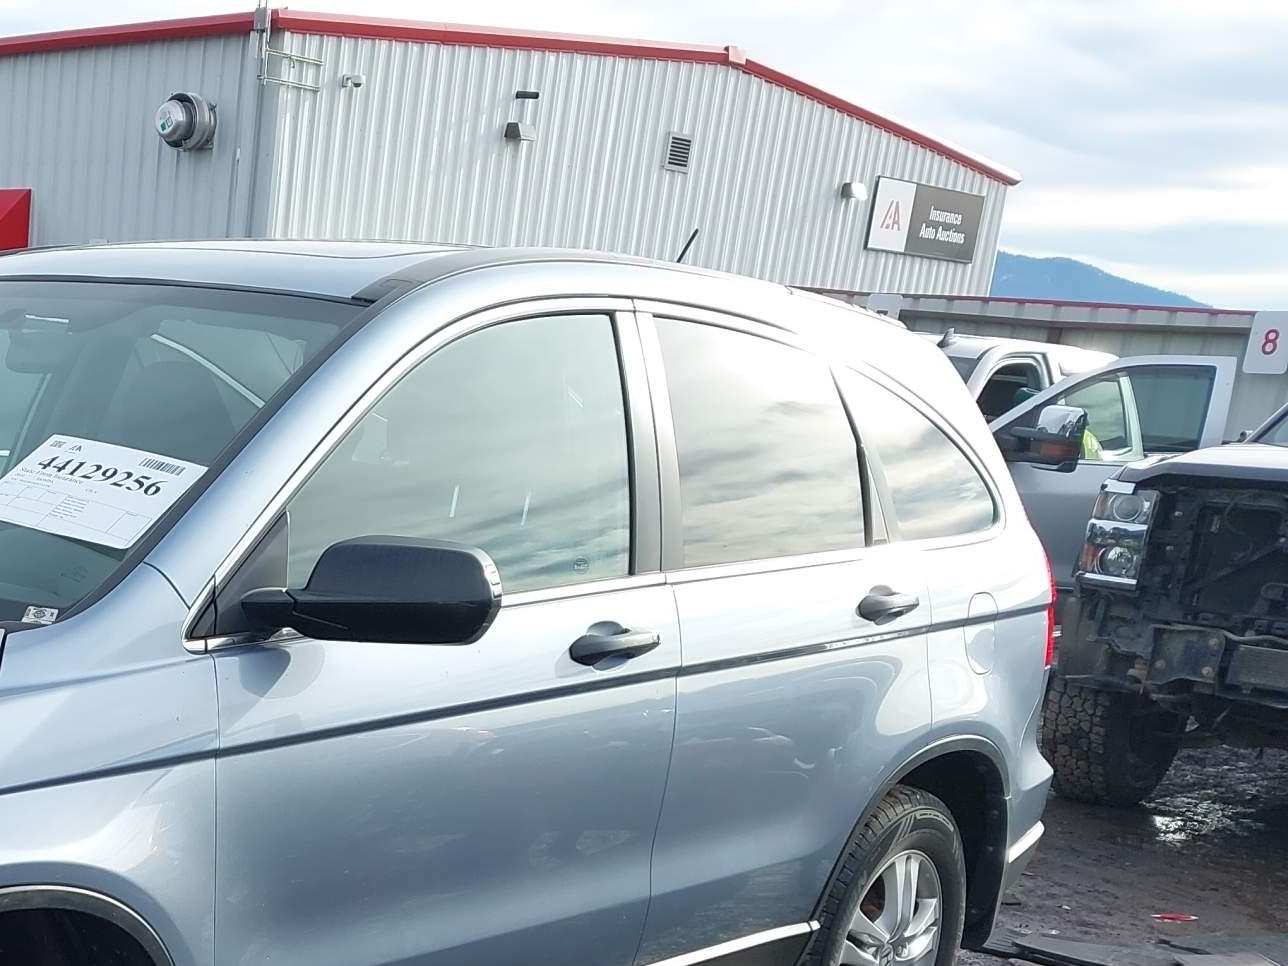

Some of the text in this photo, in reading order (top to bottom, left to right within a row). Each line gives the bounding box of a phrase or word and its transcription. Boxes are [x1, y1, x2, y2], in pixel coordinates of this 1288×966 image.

[929, 206, 963, 225] Insurance
[919, 223, 966, 245] Auto Auctions
[1262, 329, 1279, 355] 8
[38, 455, 169, 497] 44129256
